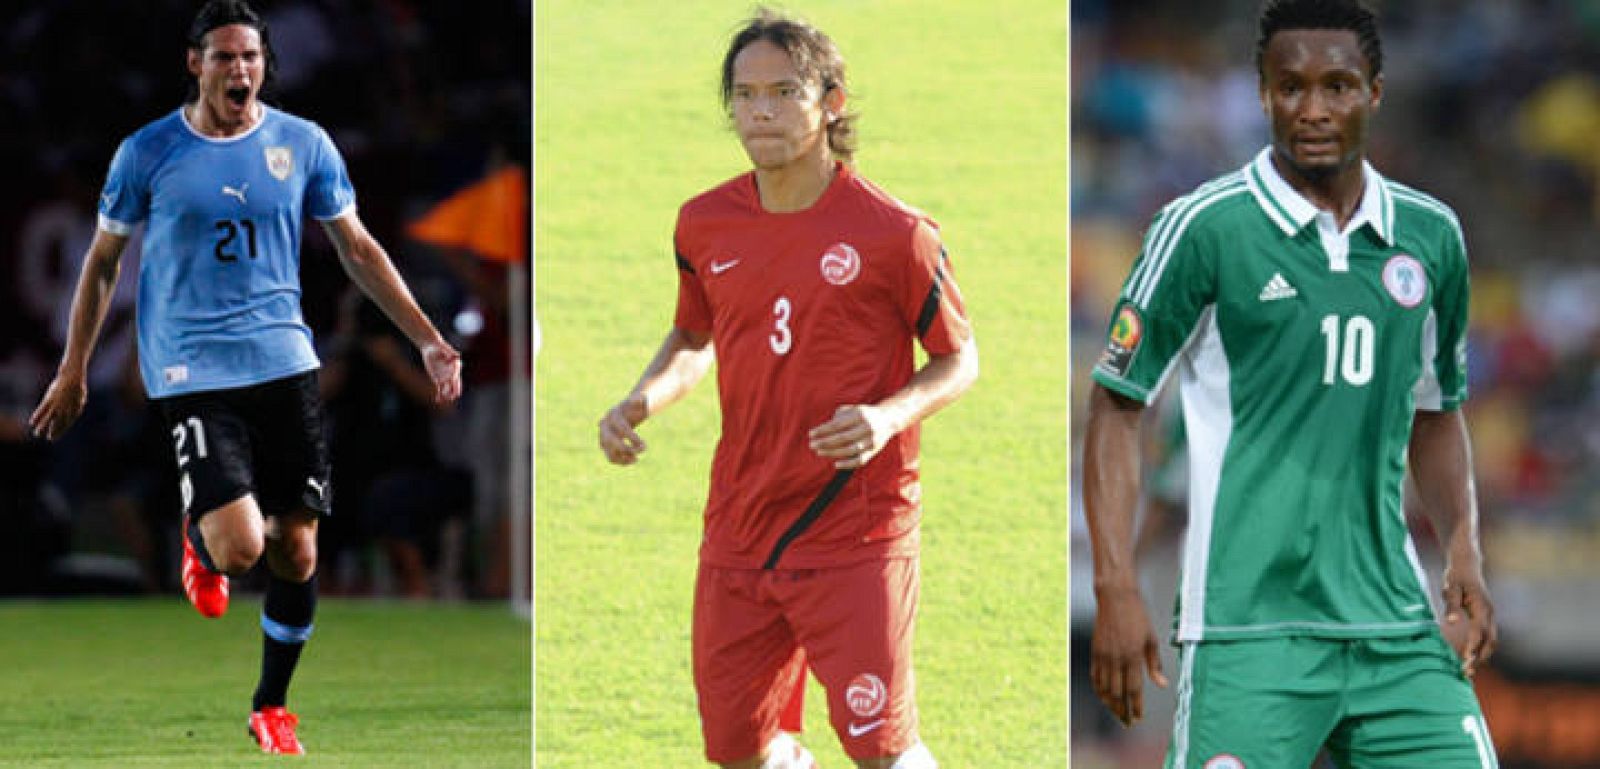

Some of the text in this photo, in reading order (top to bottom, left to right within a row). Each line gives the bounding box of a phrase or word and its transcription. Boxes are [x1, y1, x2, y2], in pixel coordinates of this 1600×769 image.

[215, 219, 256, 261] 21
[769, 296, 791, 354] 3
[1320, 314, 1375, 386] 10
[173, 416, 207, 467] 21
